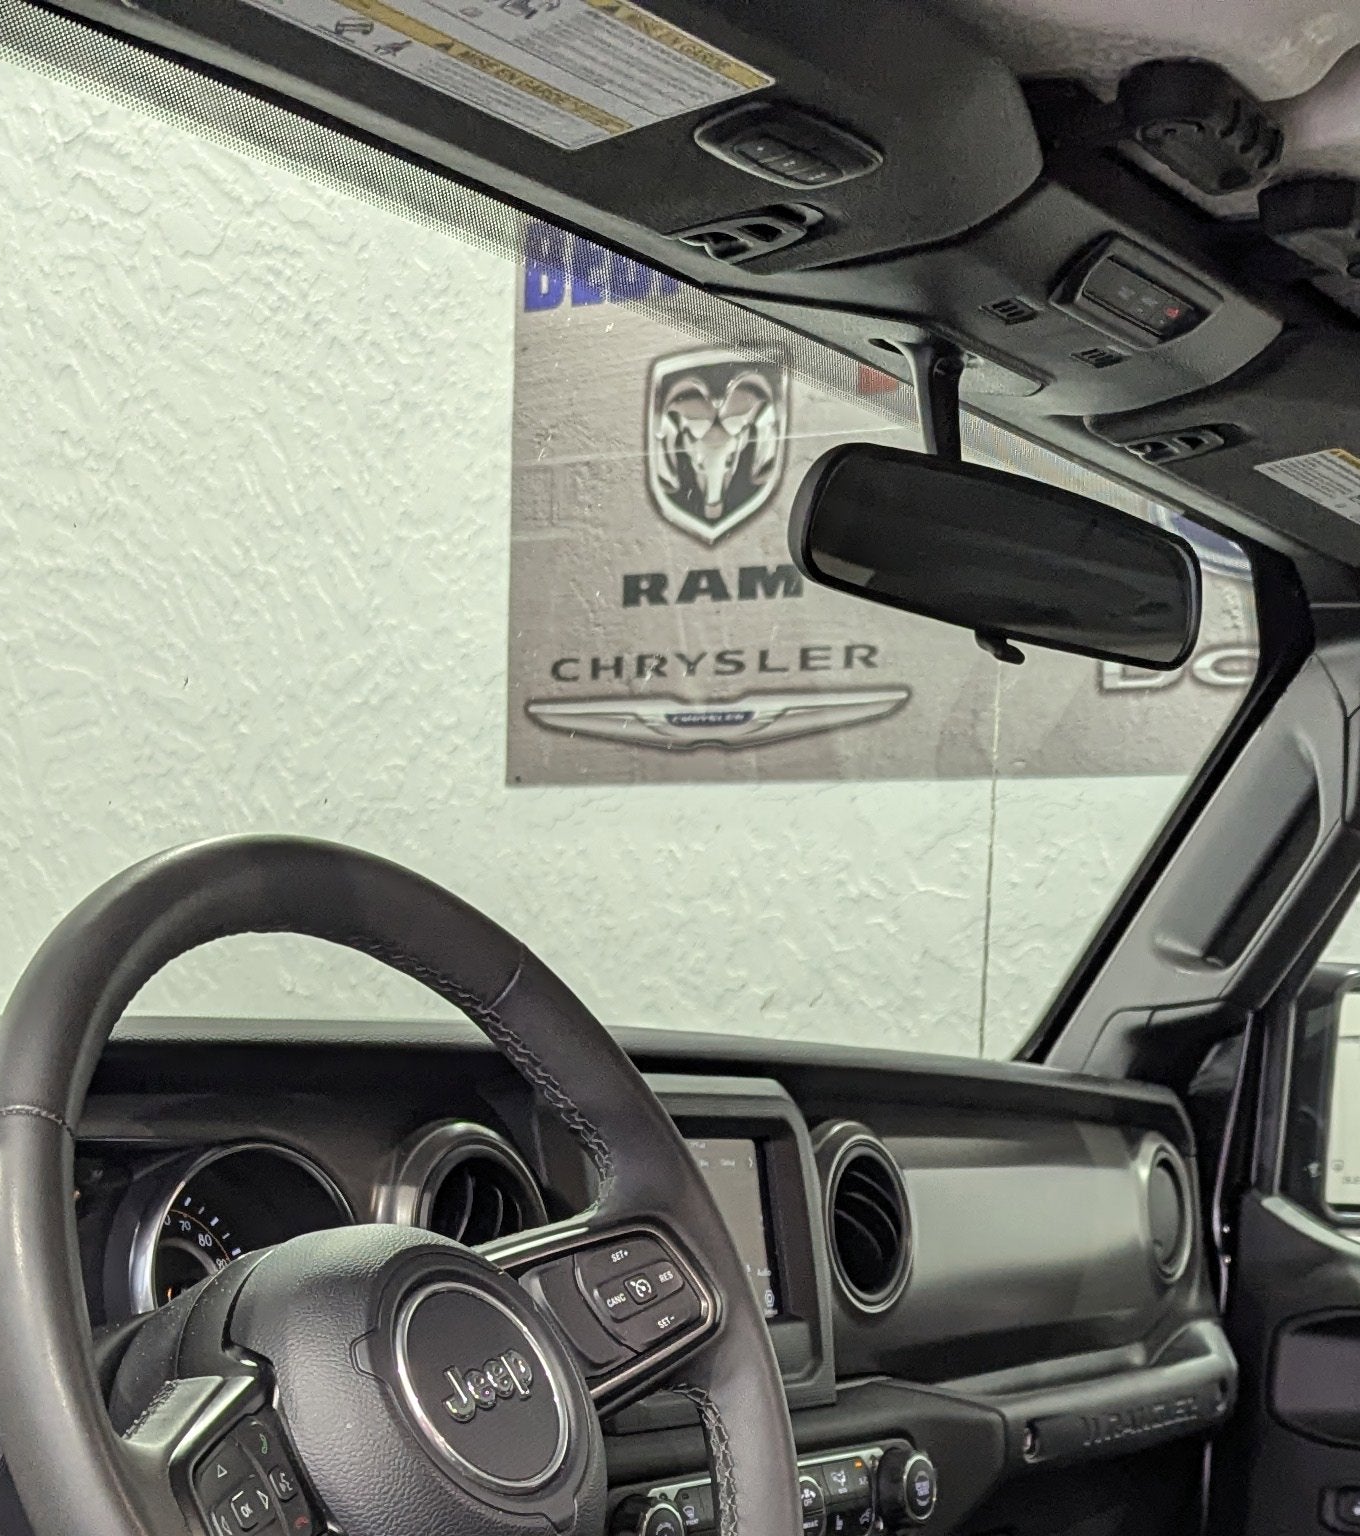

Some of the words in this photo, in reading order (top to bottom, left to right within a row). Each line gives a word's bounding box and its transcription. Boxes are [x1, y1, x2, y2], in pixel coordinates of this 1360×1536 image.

[622, 564, 804, 608] RAM
[551, 644, 881, 683] CHRYSLER
[179, 1220, 191, 1231] 70
[198, 1233, 213, 1247] 80
[215, 1258, 228, 1270] 90
[658, 1270, 674, 1283] RES
[606, 1292, 627, 1308] CANC
[442, 1349, 533, 1424] Jeep
[239, 1502, 253, 1518] OK
